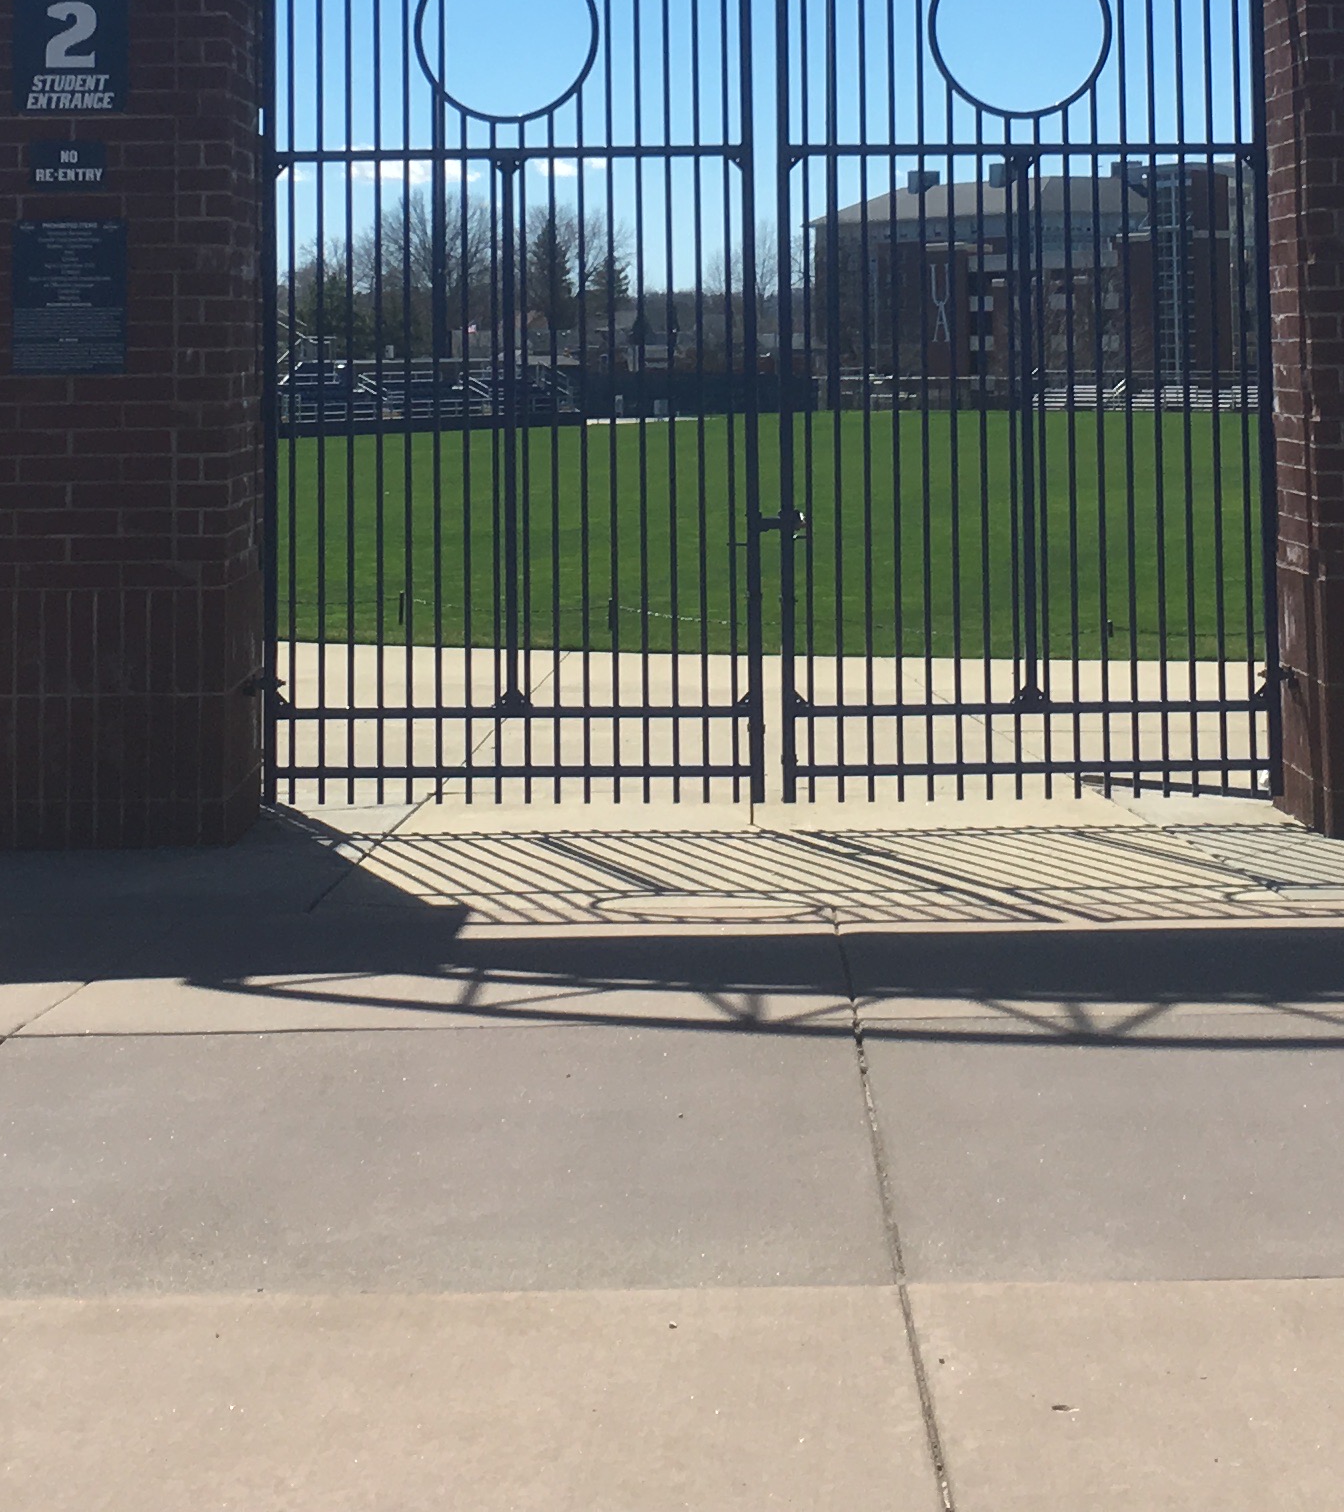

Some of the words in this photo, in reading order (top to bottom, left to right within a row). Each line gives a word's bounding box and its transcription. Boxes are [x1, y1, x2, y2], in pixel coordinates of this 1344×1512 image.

[45, 1, 97, 68] 2
[31, 74, 110, 91] STUDENT
[26, 92, 115, 110] ENTRANCE
[60, 150, 78, 164] NO
